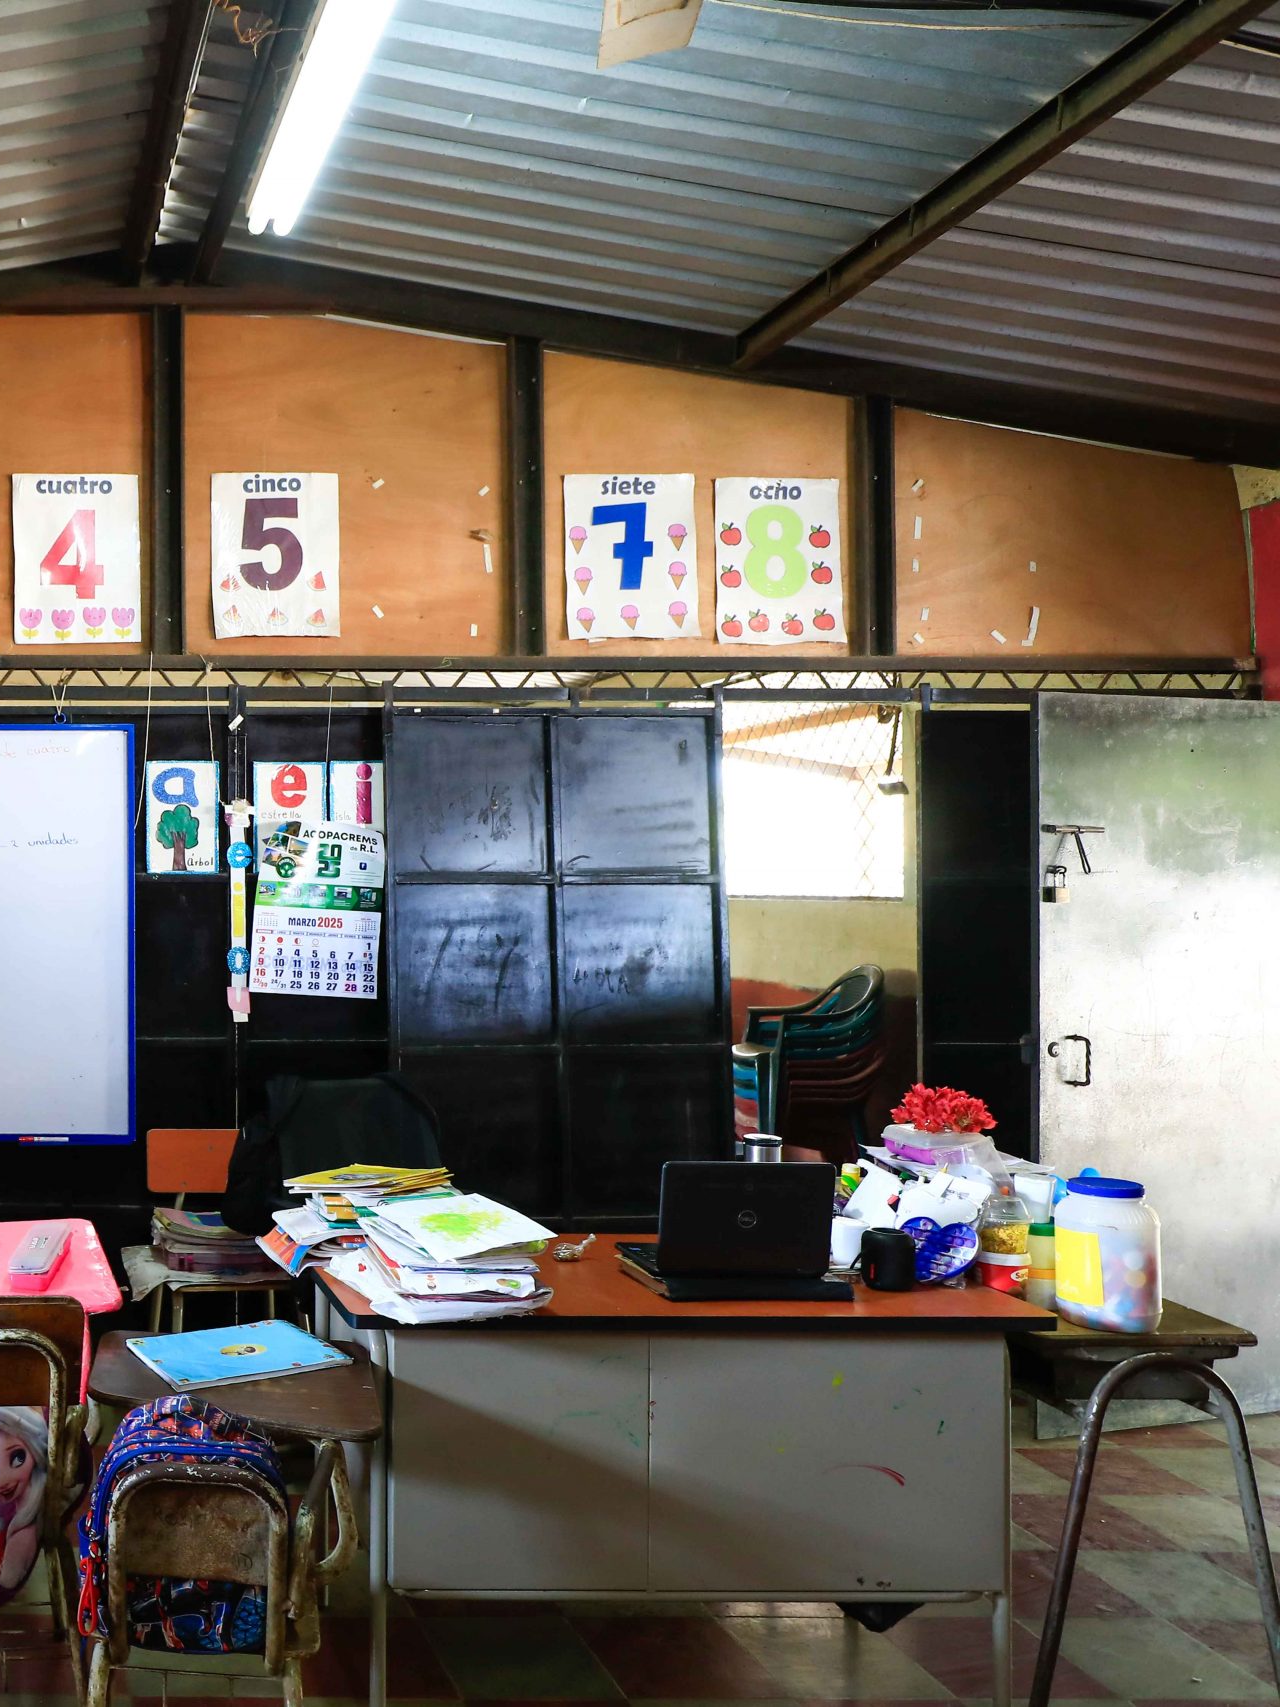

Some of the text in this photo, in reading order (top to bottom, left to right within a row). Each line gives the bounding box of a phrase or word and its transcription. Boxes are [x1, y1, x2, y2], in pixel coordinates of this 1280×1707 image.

[36, 477, 113, 495] cuatro
[242, 474, 302, 494] cinco
[601, 477, 656, 496] siete
[749, 480, 802, 501] ocho
[40, 509, 104, 599] 4
[238, 498, 303, 591] 5
[592, 502, 653, 590] 7
[743, 505, 808, 599] 8
[152, 767, 199, 807] a
[271, 764, 307, 808] e
[356, 763, 372, 824] i
[27, 831, 80, 848] unidades
[360, 845, 379, 854] R.L.
[187, 853, 213, 867] árbol
[288, 917, 316, 927] MARZO
[317, 917, 343, 928] 2025
[277, 948, 283, 956] 3
[294, 949, 300, 957] 4
[312, 950, 318, 958] 5
[330, 951, 336, 959] 6
[348, 952, 354, 960] 7
[258, 957, 373, 972] 9 10 11 12 13 14 15
[256, 968, 375, 982] 16 17 18 19 20 21 22
[290, 981, 302, 989] 25
[308, 982, 320, 990] 26
[326, 982, 337, 991] 27
[345, 983, 357, 992] 28
[363, 984, 375, 993] 29
